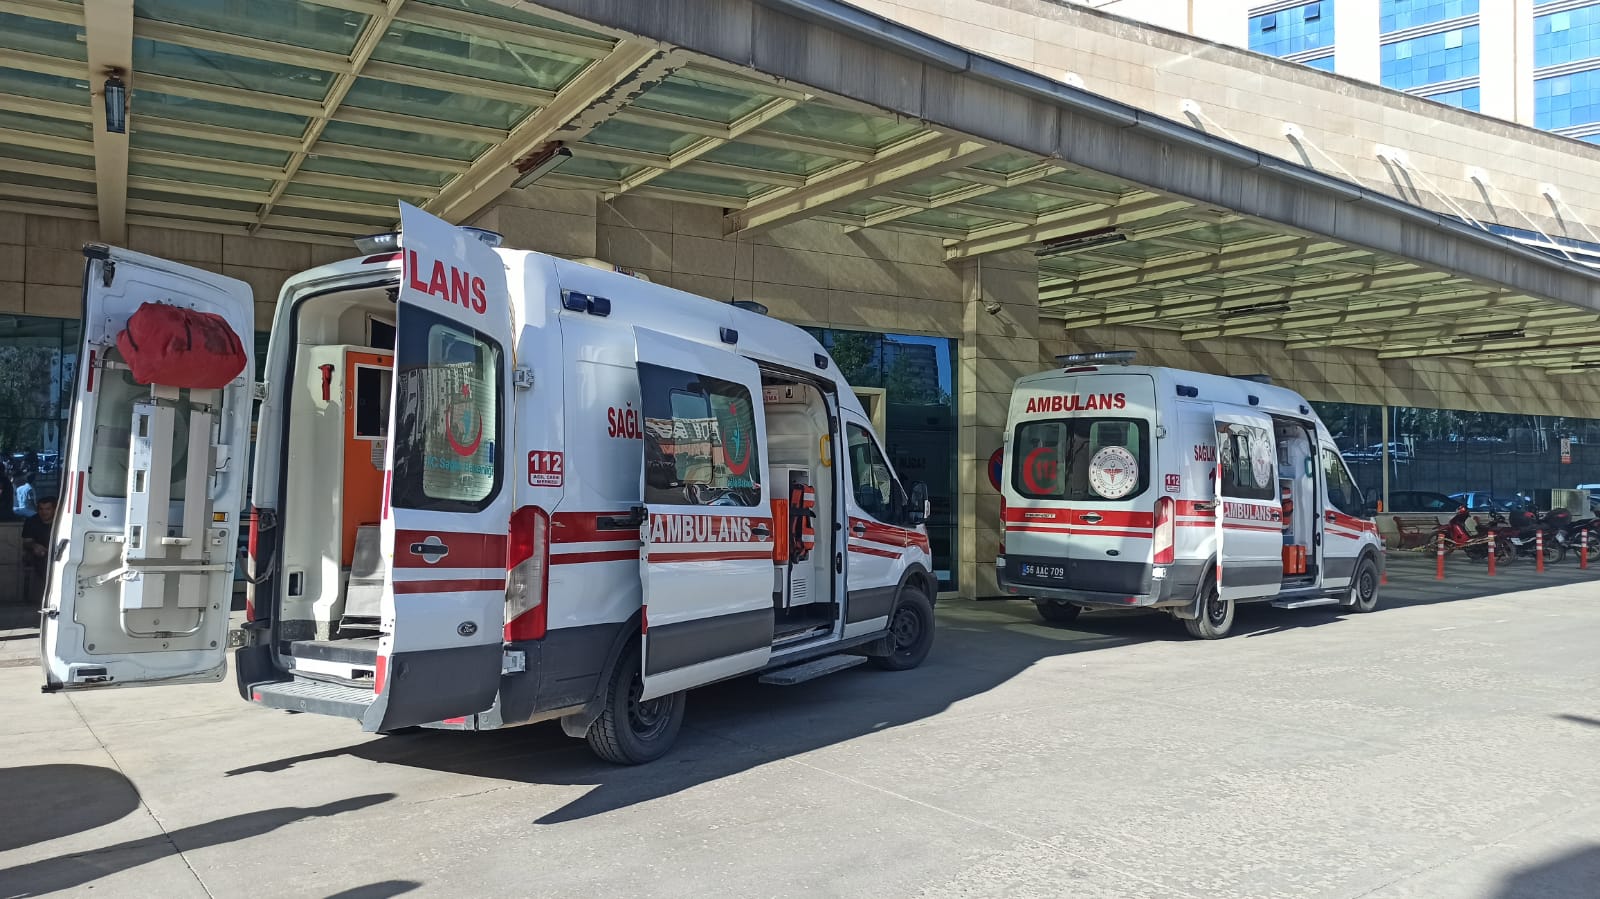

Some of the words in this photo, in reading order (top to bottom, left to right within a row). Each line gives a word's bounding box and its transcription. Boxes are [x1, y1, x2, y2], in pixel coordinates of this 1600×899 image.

[402, 247, 487, 315] LANS
[1027, 393, 1126, 413] AMBULANS
[530, 453, 562, 472] 112
[1166, 475, 1180, 486] 112
[1223, 502, 1272, 521] AMBULANS
[650, 515, 752, 543] AMBULANS
[1026, 565, 1034, 574] 56
[1036, 566, 1049, 575] AAC
[1050, 567, 1064, 576] 709
